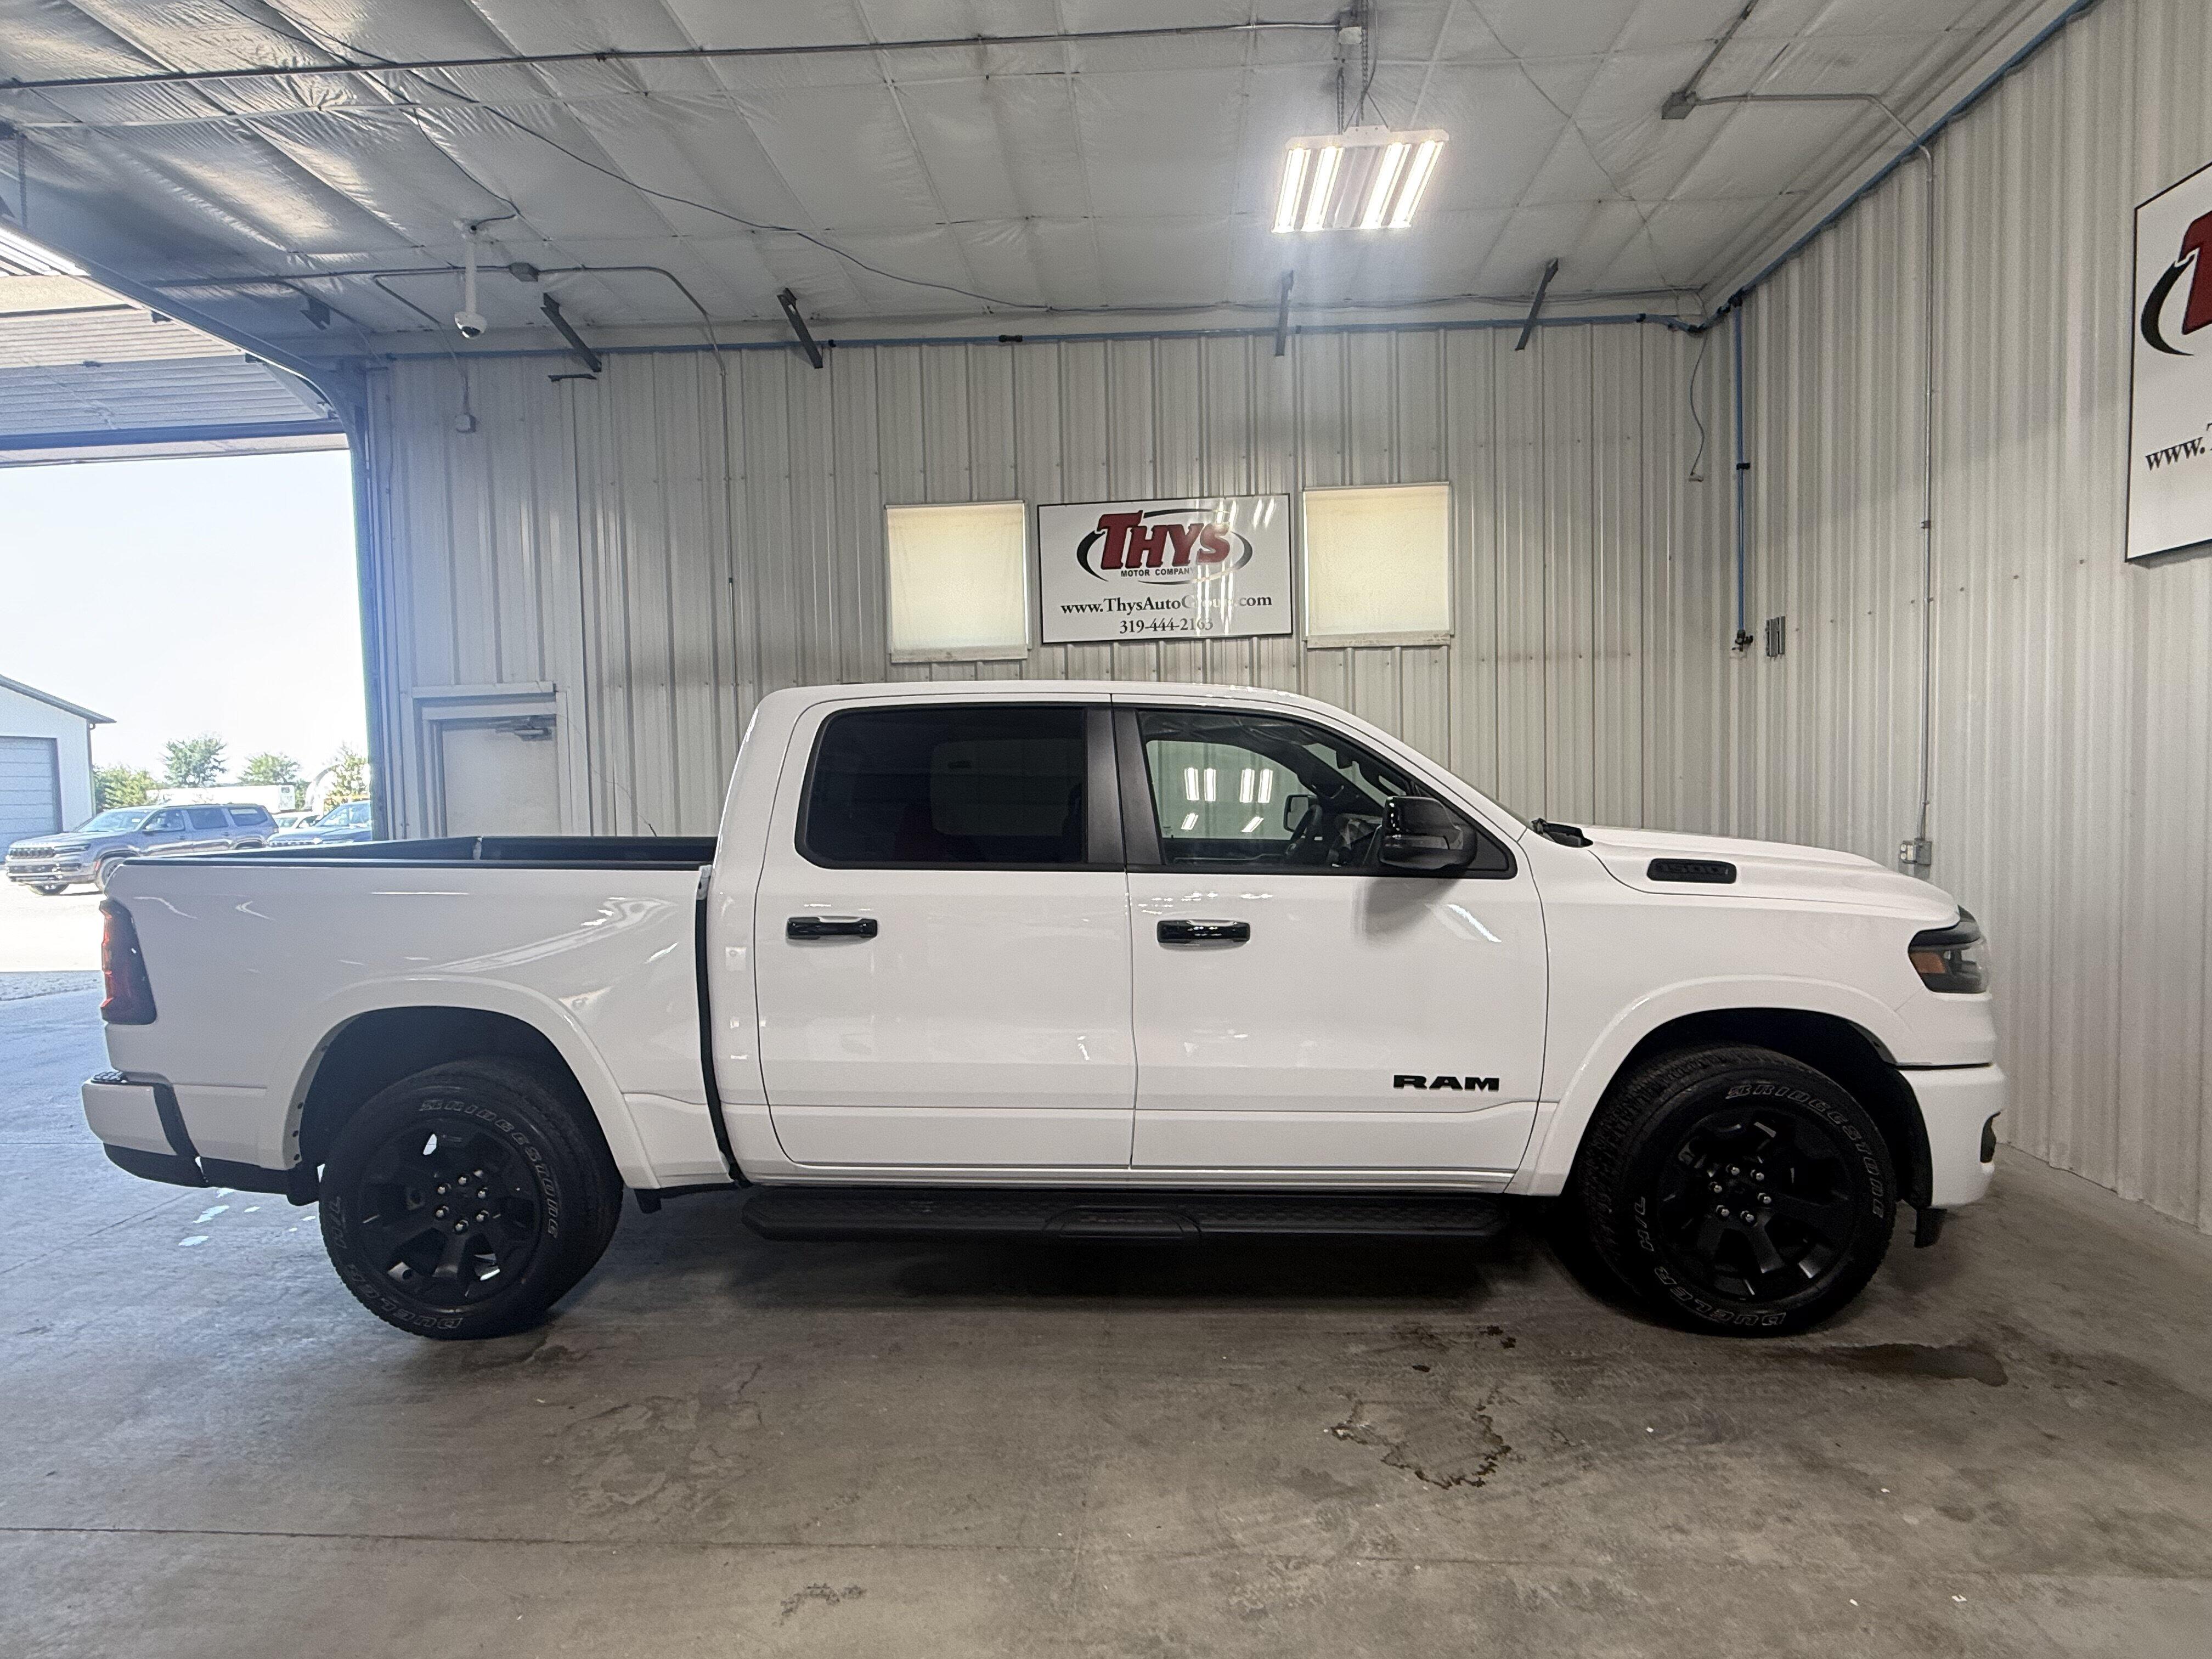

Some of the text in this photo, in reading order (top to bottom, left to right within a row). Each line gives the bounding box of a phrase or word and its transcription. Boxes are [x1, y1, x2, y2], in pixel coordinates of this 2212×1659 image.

[2145, 423, 2212, 471] www.
[1097, 510, 1231, 570] THYS
[1121, 569, 1150, 577] MOTOR
[1060, 595, 1272, 615] www.ThysAutoGucom
[1119, 617, 1214, 634] 319-444-2163
[1393, 1075, 1500, 1092] RAM
[419, 1099, 561, 1238] BRIDGESTONE
[1726, 1084, 1884, 1218] BRIDGESTONE
[1634, 1197, 1786, 1326] DUELER H/L
[347, 1264, 464, 1329] DUELER
